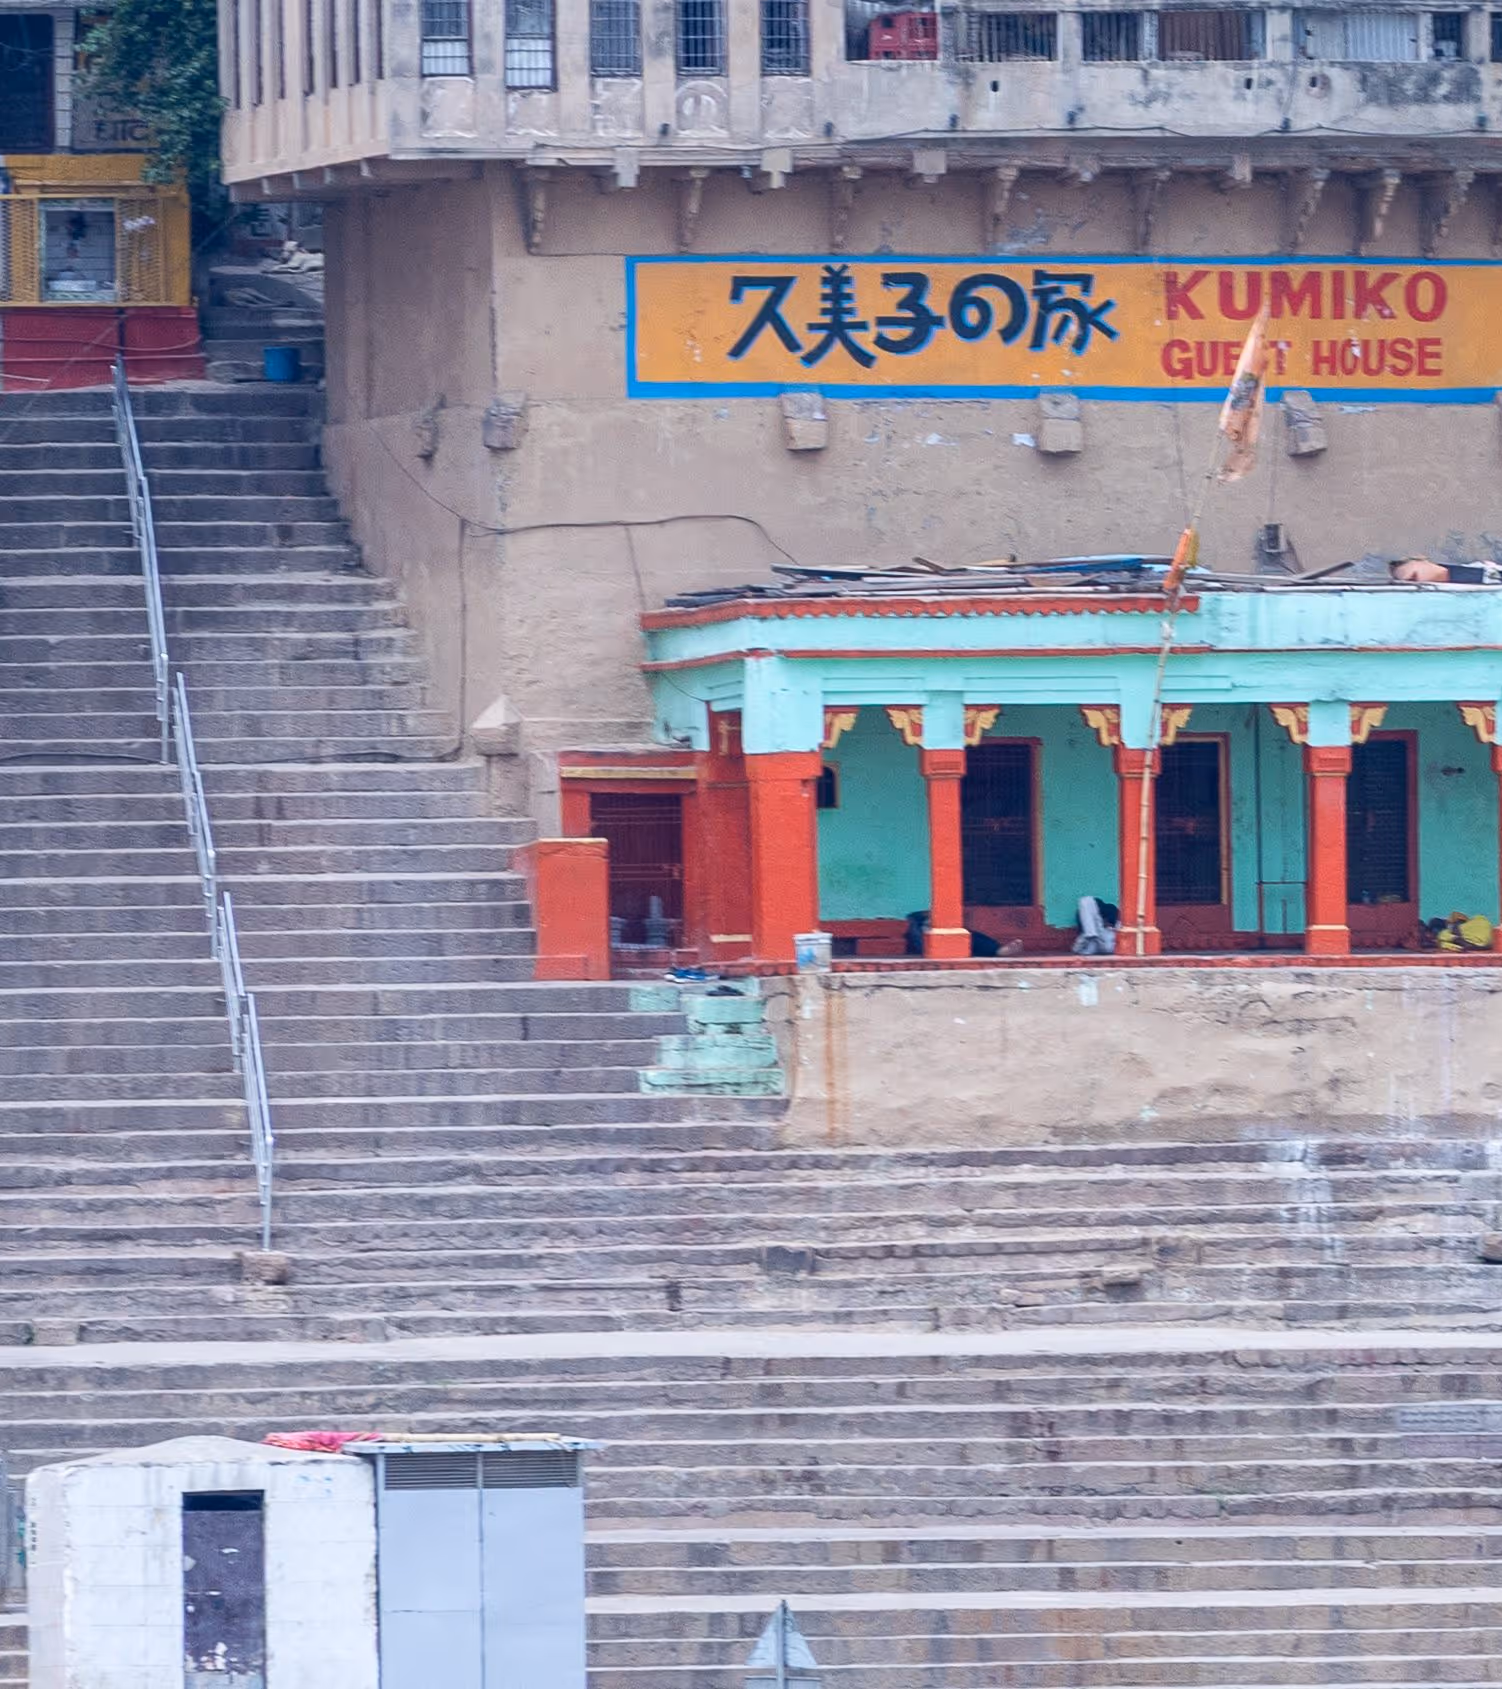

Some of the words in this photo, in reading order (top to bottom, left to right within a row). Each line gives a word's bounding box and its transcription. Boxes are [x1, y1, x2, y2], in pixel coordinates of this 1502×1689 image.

[1164, 270, 1448, 322] KUMIKO
[1161, 338, 1293, 380] GUET
[1312, 337, 1445, 377] HOUSE
